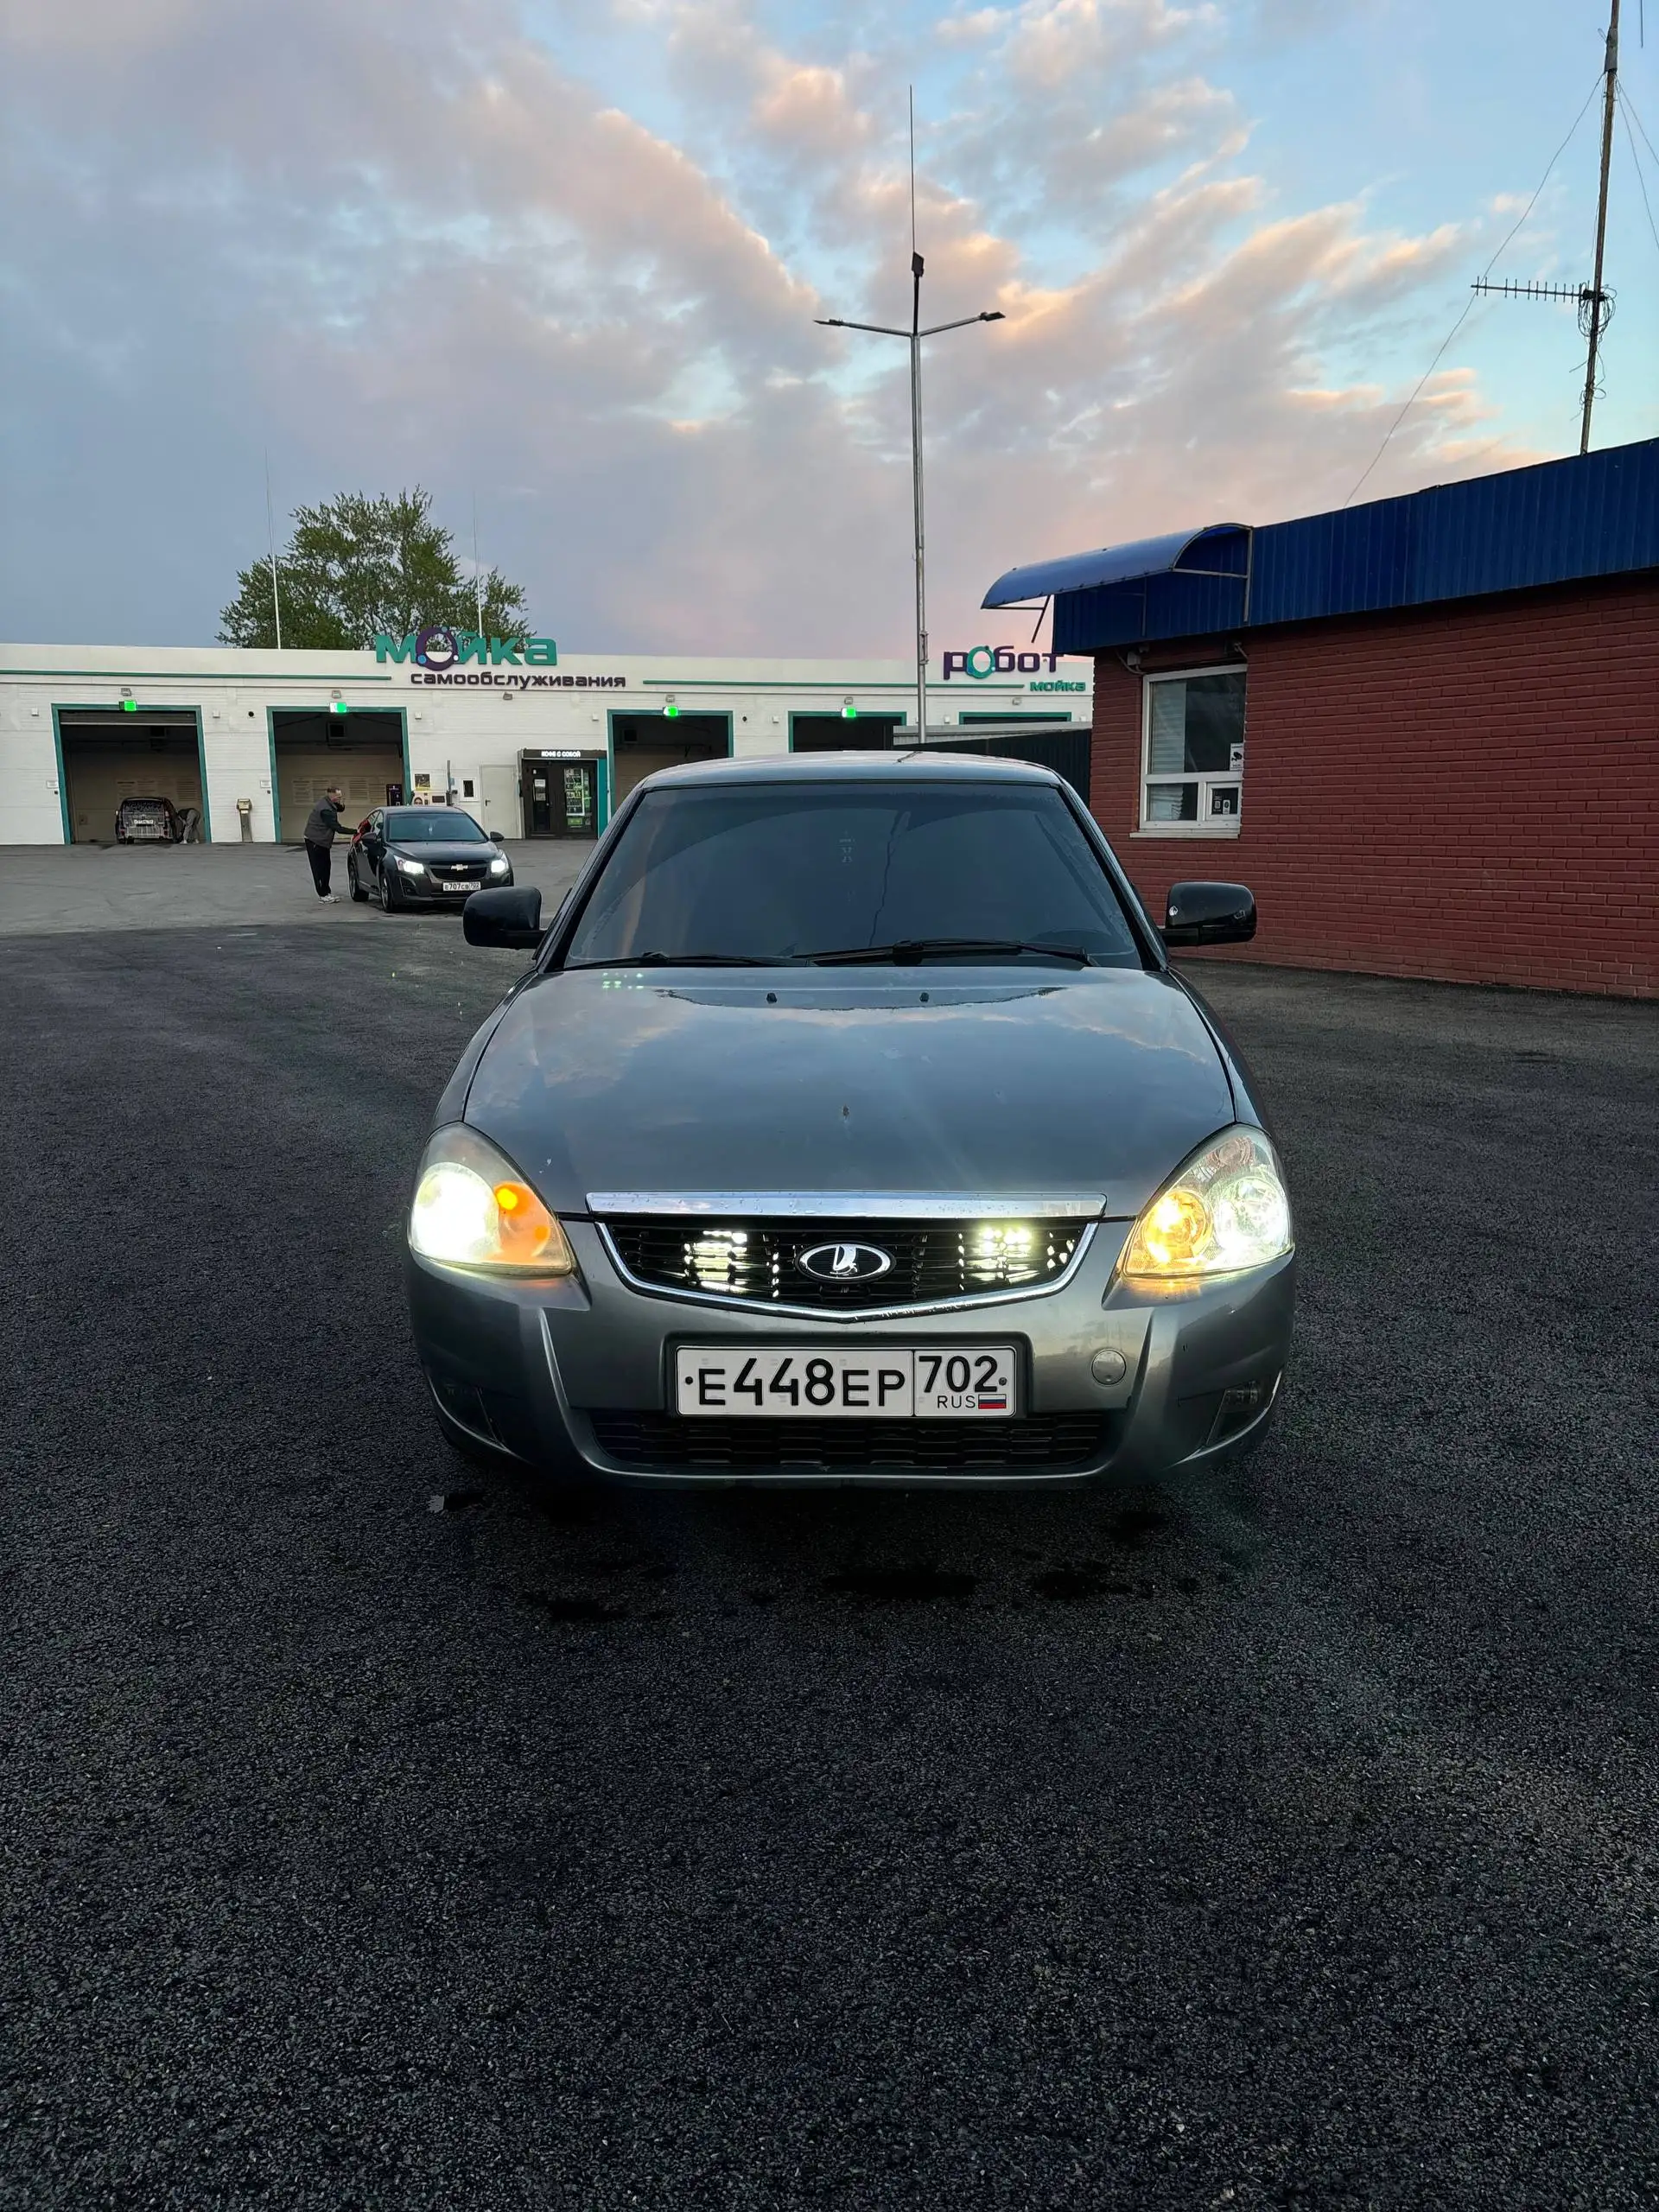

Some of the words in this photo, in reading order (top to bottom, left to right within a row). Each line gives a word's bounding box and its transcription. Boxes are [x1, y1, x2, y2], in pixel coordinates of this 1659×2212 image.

[410, 671, 626, 690] самообслуживания
[918, 1355, 999, 1393] 702
[938, 1395, 976, 1409] RUS
